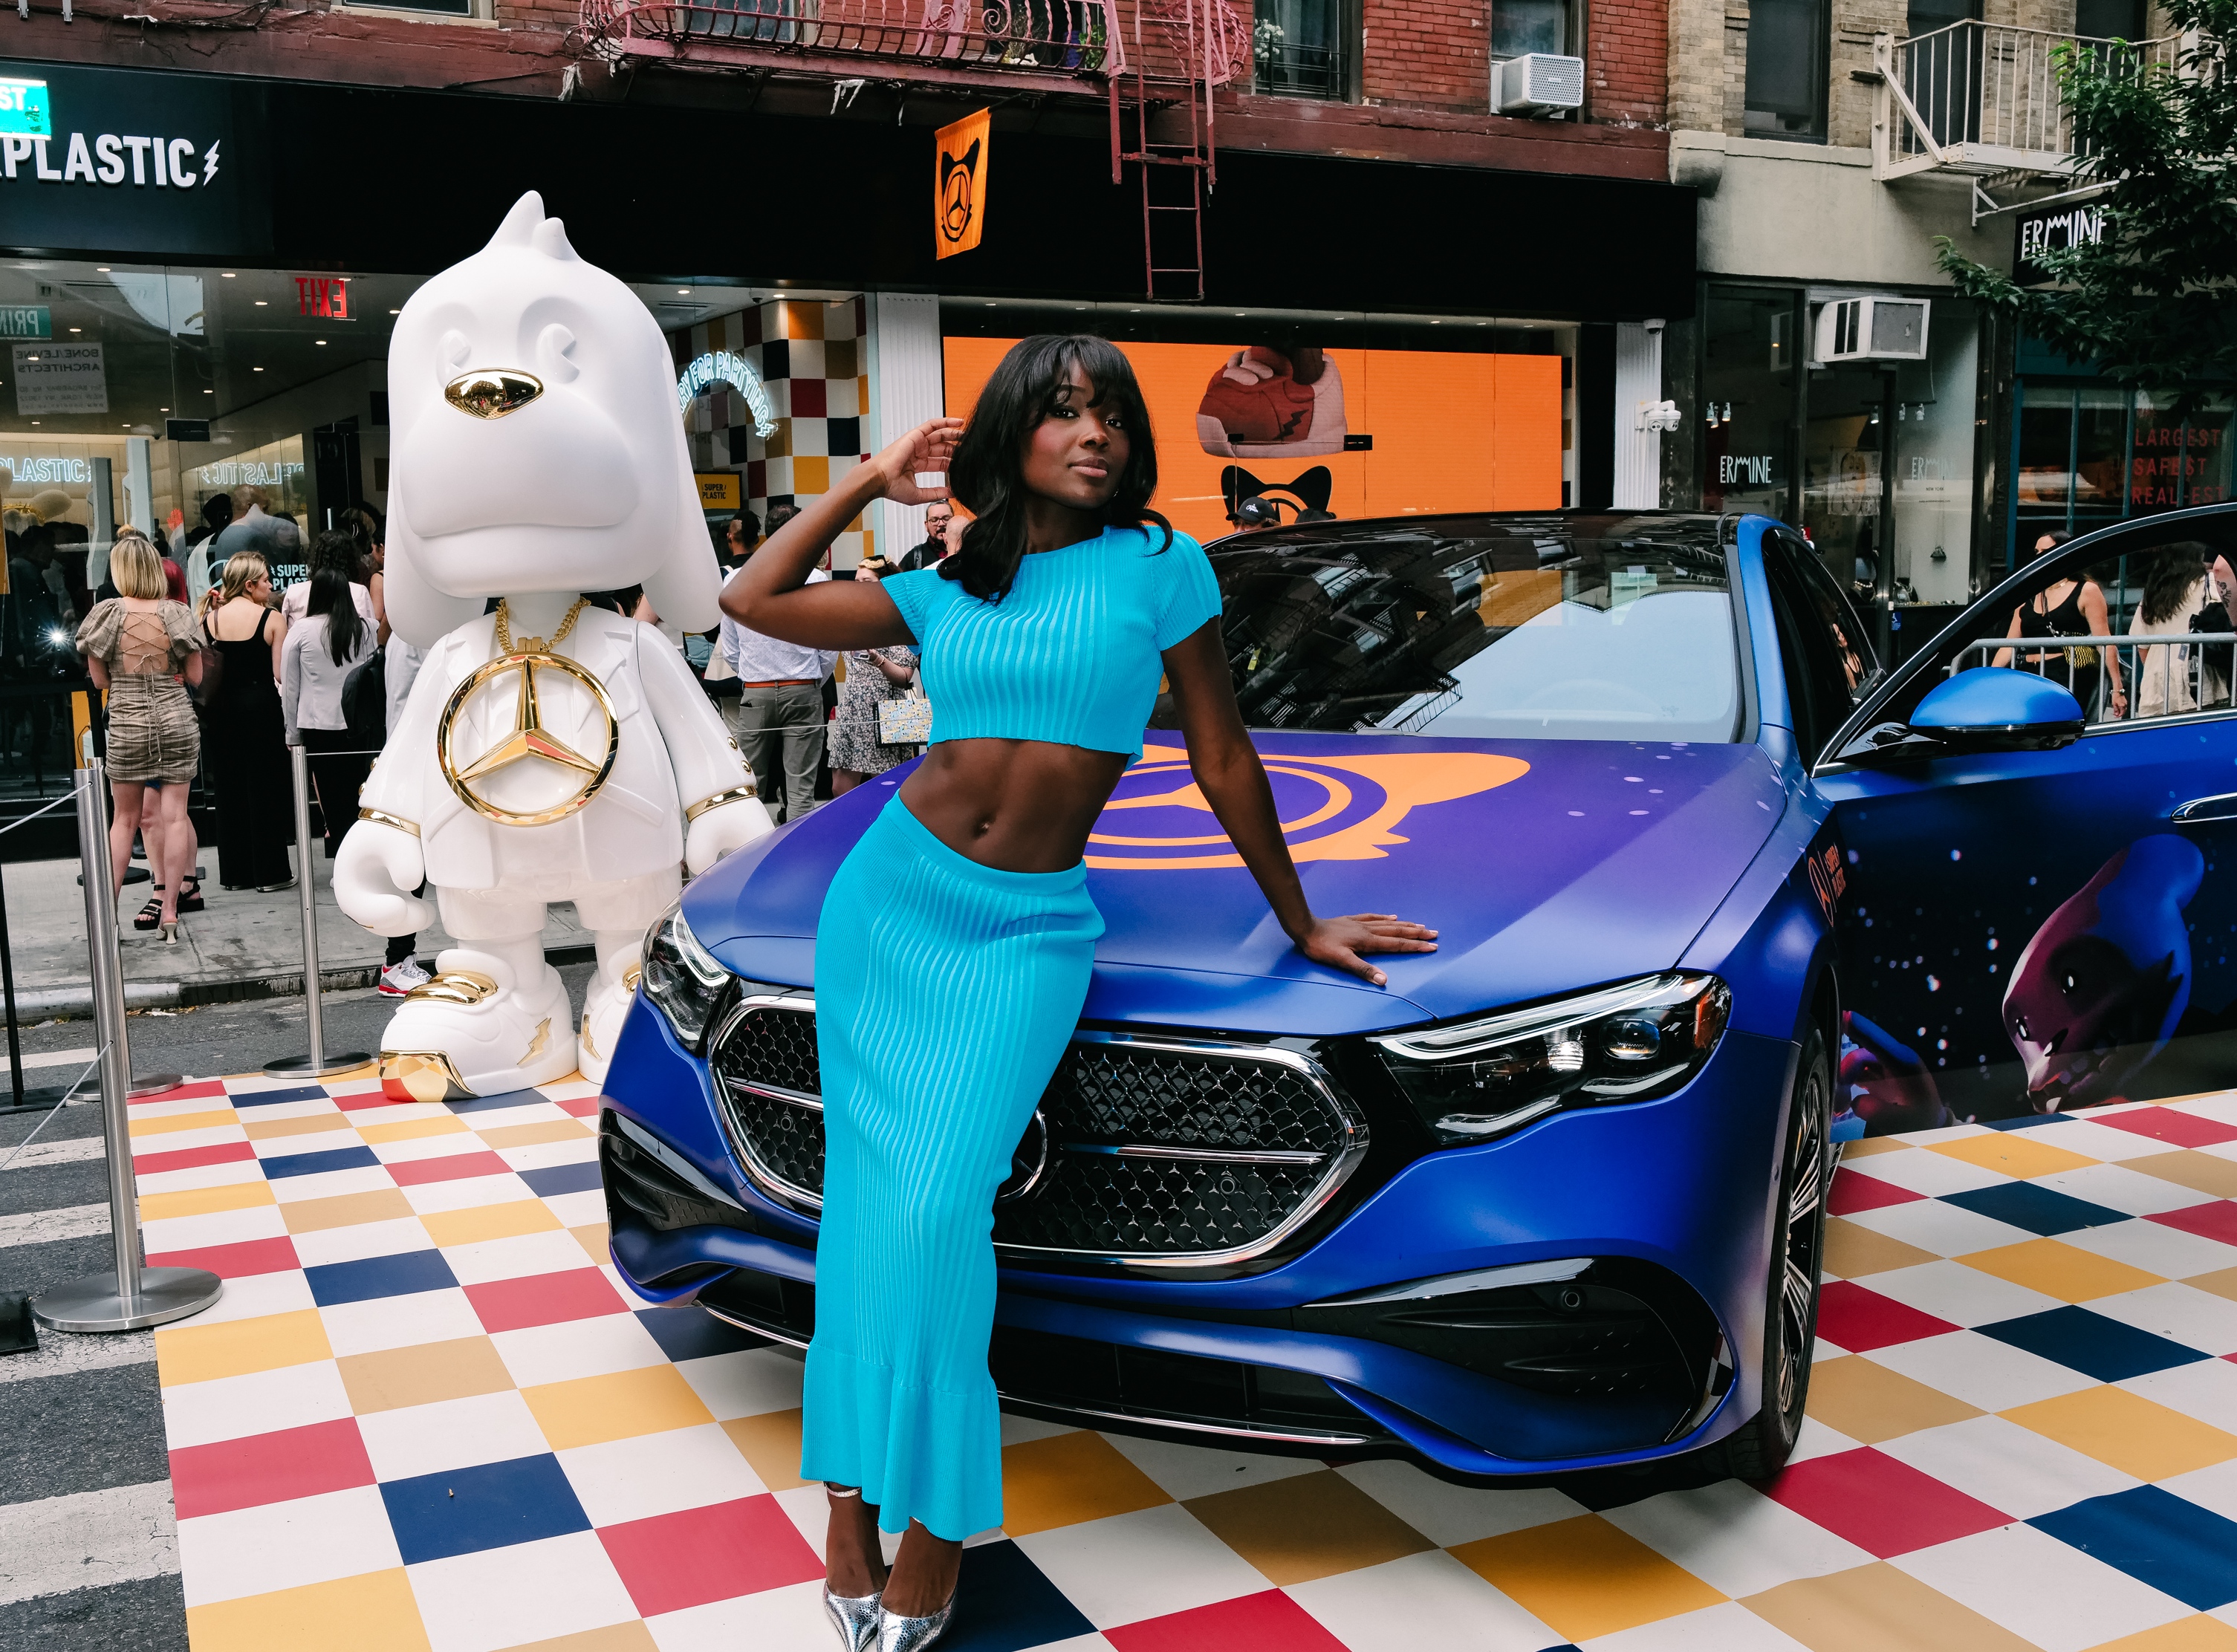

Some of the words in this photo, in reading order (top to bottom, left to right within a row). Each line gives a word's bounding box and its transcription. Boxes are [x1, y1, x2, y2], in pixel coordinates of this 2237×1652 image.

[0, 132, 197, 188] PLASTIC
[677, 370, 692, 414] RY
[689, 353, 715, 391] FOR
[715, 351, 768, 428] PARTYING
[2134, 428, 2221, 446] LARGEST
[1720, 455, 1773, 484] ERMINE
[2132, 458, 2207, 475] SAFEST
[702, 491, 726, 500] PLASTIC
